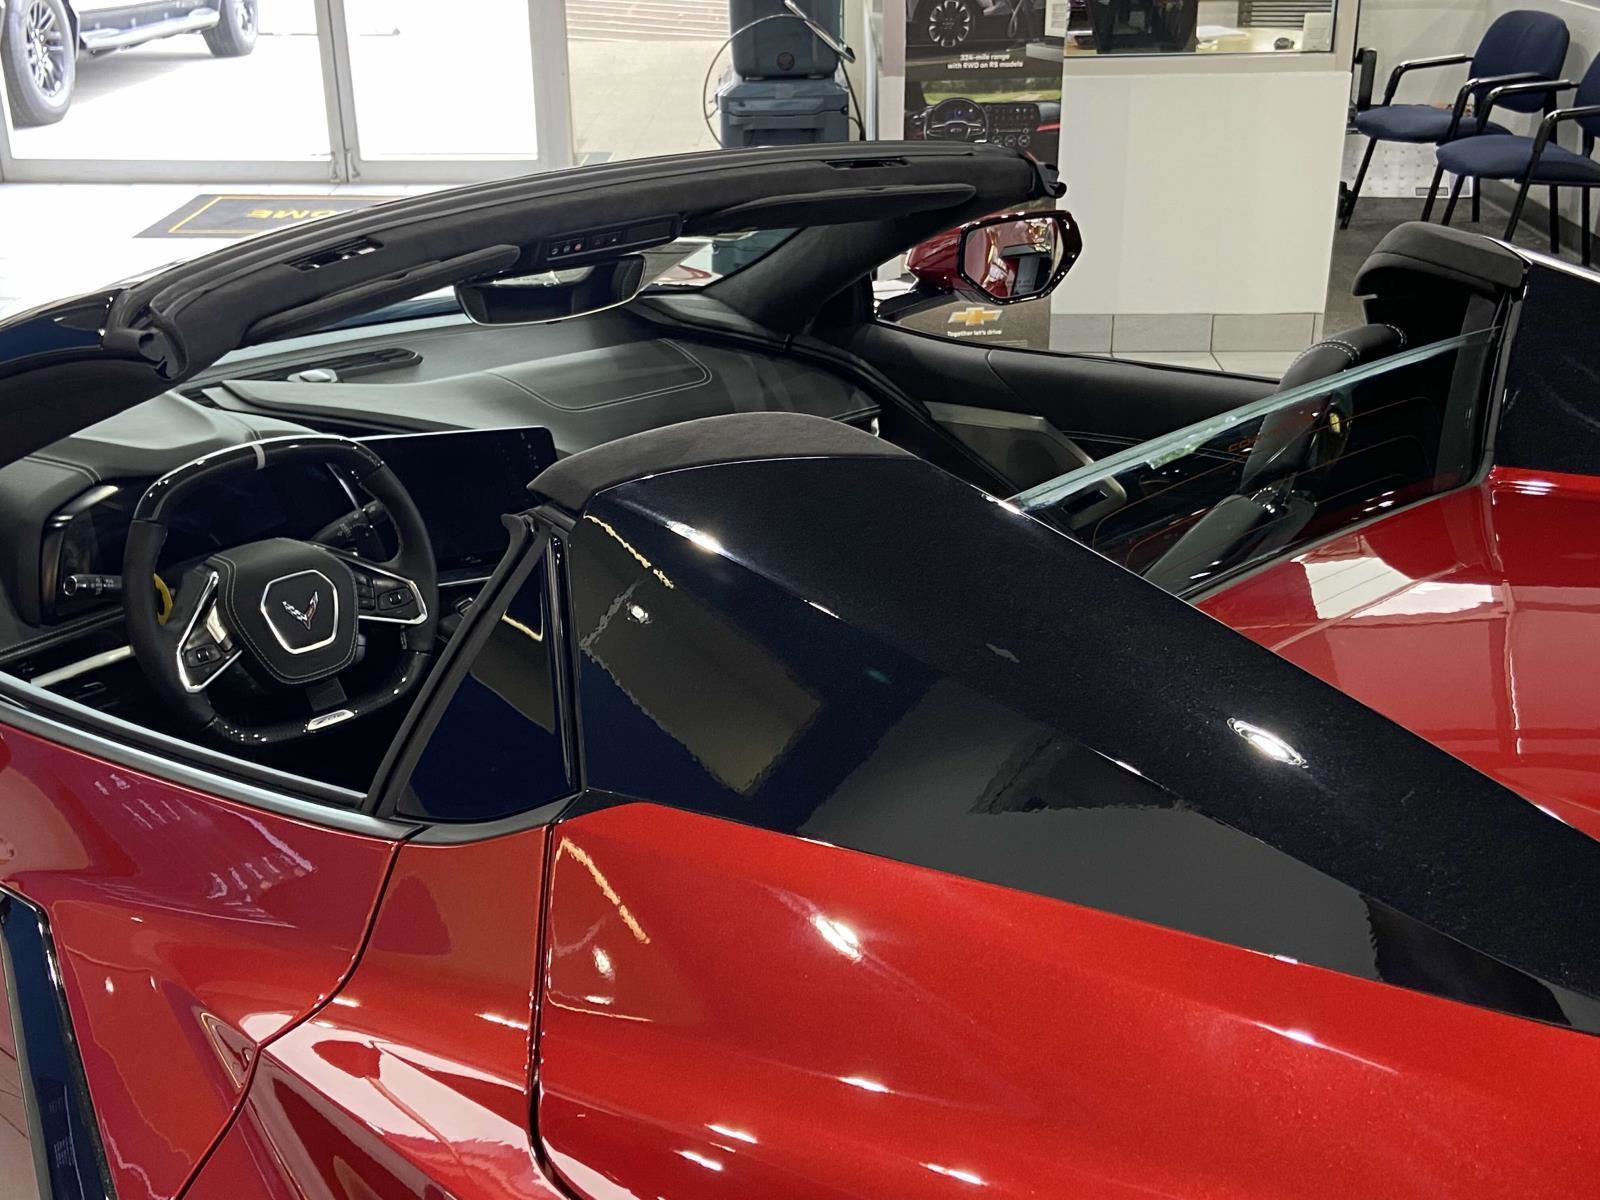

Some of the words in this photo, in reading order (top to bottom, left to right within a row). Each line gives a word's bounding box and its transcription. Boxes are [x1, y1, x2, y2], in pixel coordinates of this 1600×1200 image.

[990, 54, 1011, 62] range
[999, 60, 1023, 68] models
[947, 330, 973, 338] Together
